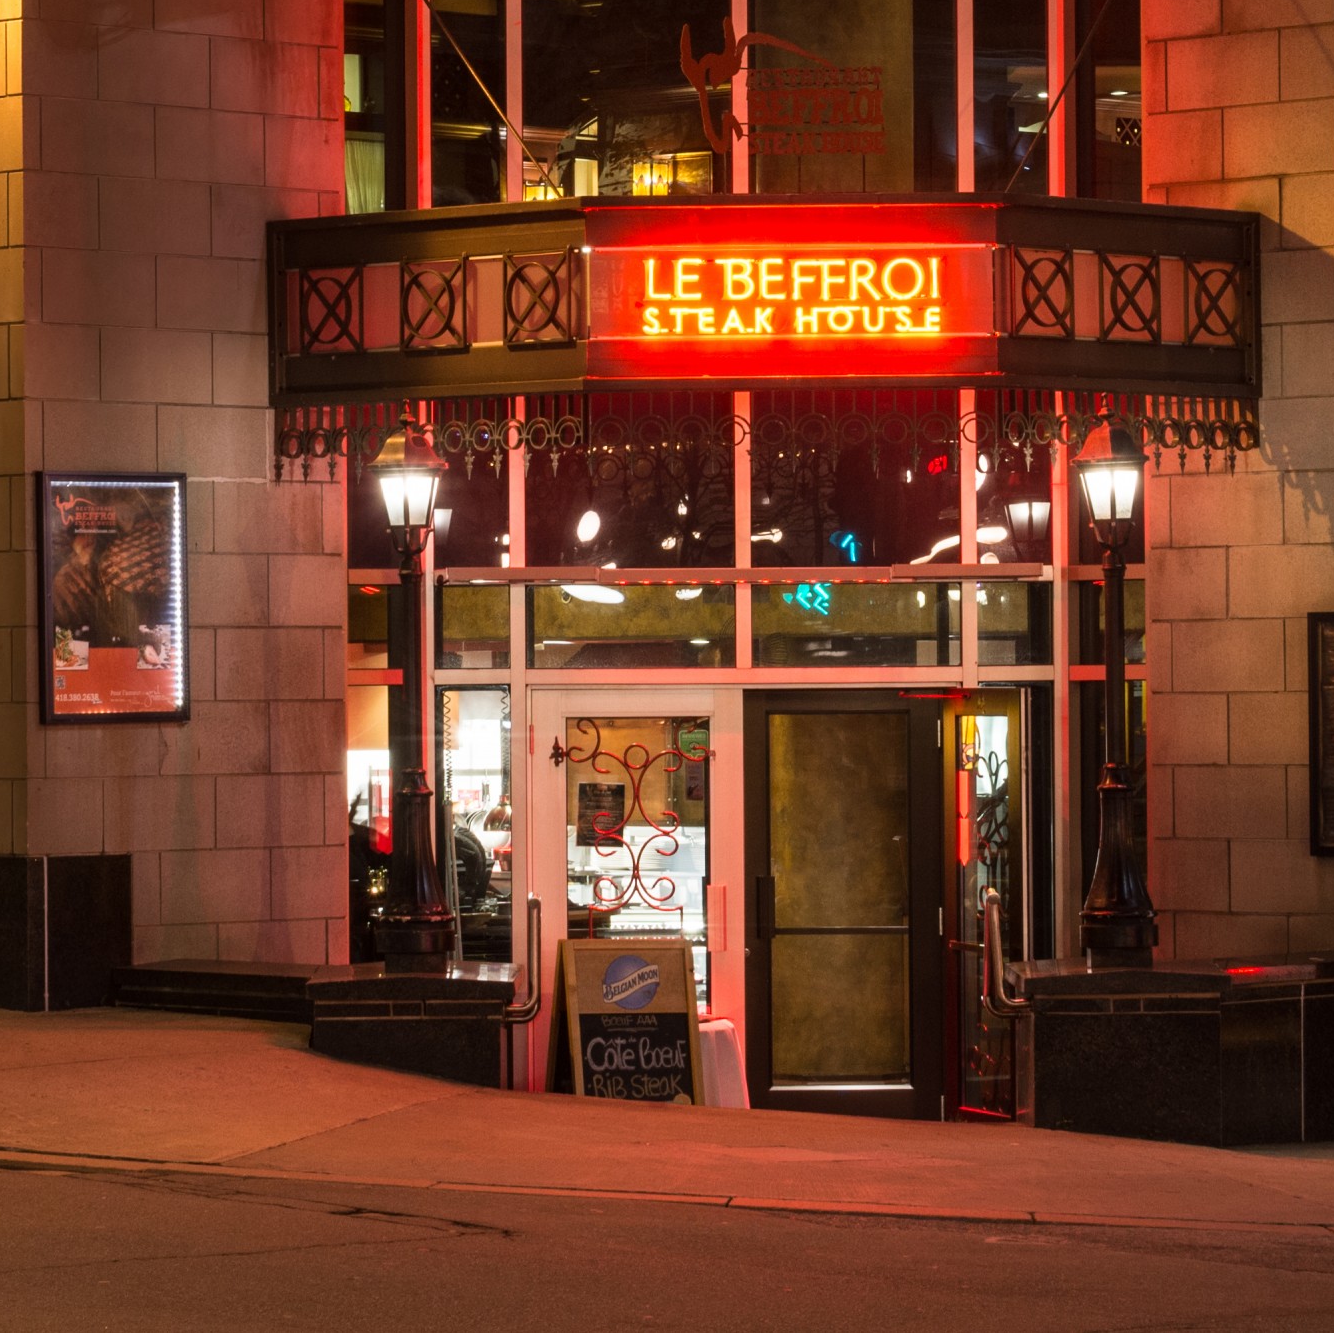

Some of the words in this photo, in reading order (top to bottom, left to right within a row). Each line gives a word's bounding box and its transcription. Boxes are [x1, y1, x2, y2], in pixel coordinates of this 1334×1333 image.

[747, 88, 885, 127] BEFFROI
[643, 257, 704, 301] LE
[717, 257, 942, 301] BEFFROI
[642, 306, 775, 336] STEAK
[794, 305, 942, 335] HOUSE
[603, 976, 637, 1002] BELGIAN
[637, 968, 658, 986] MOON
